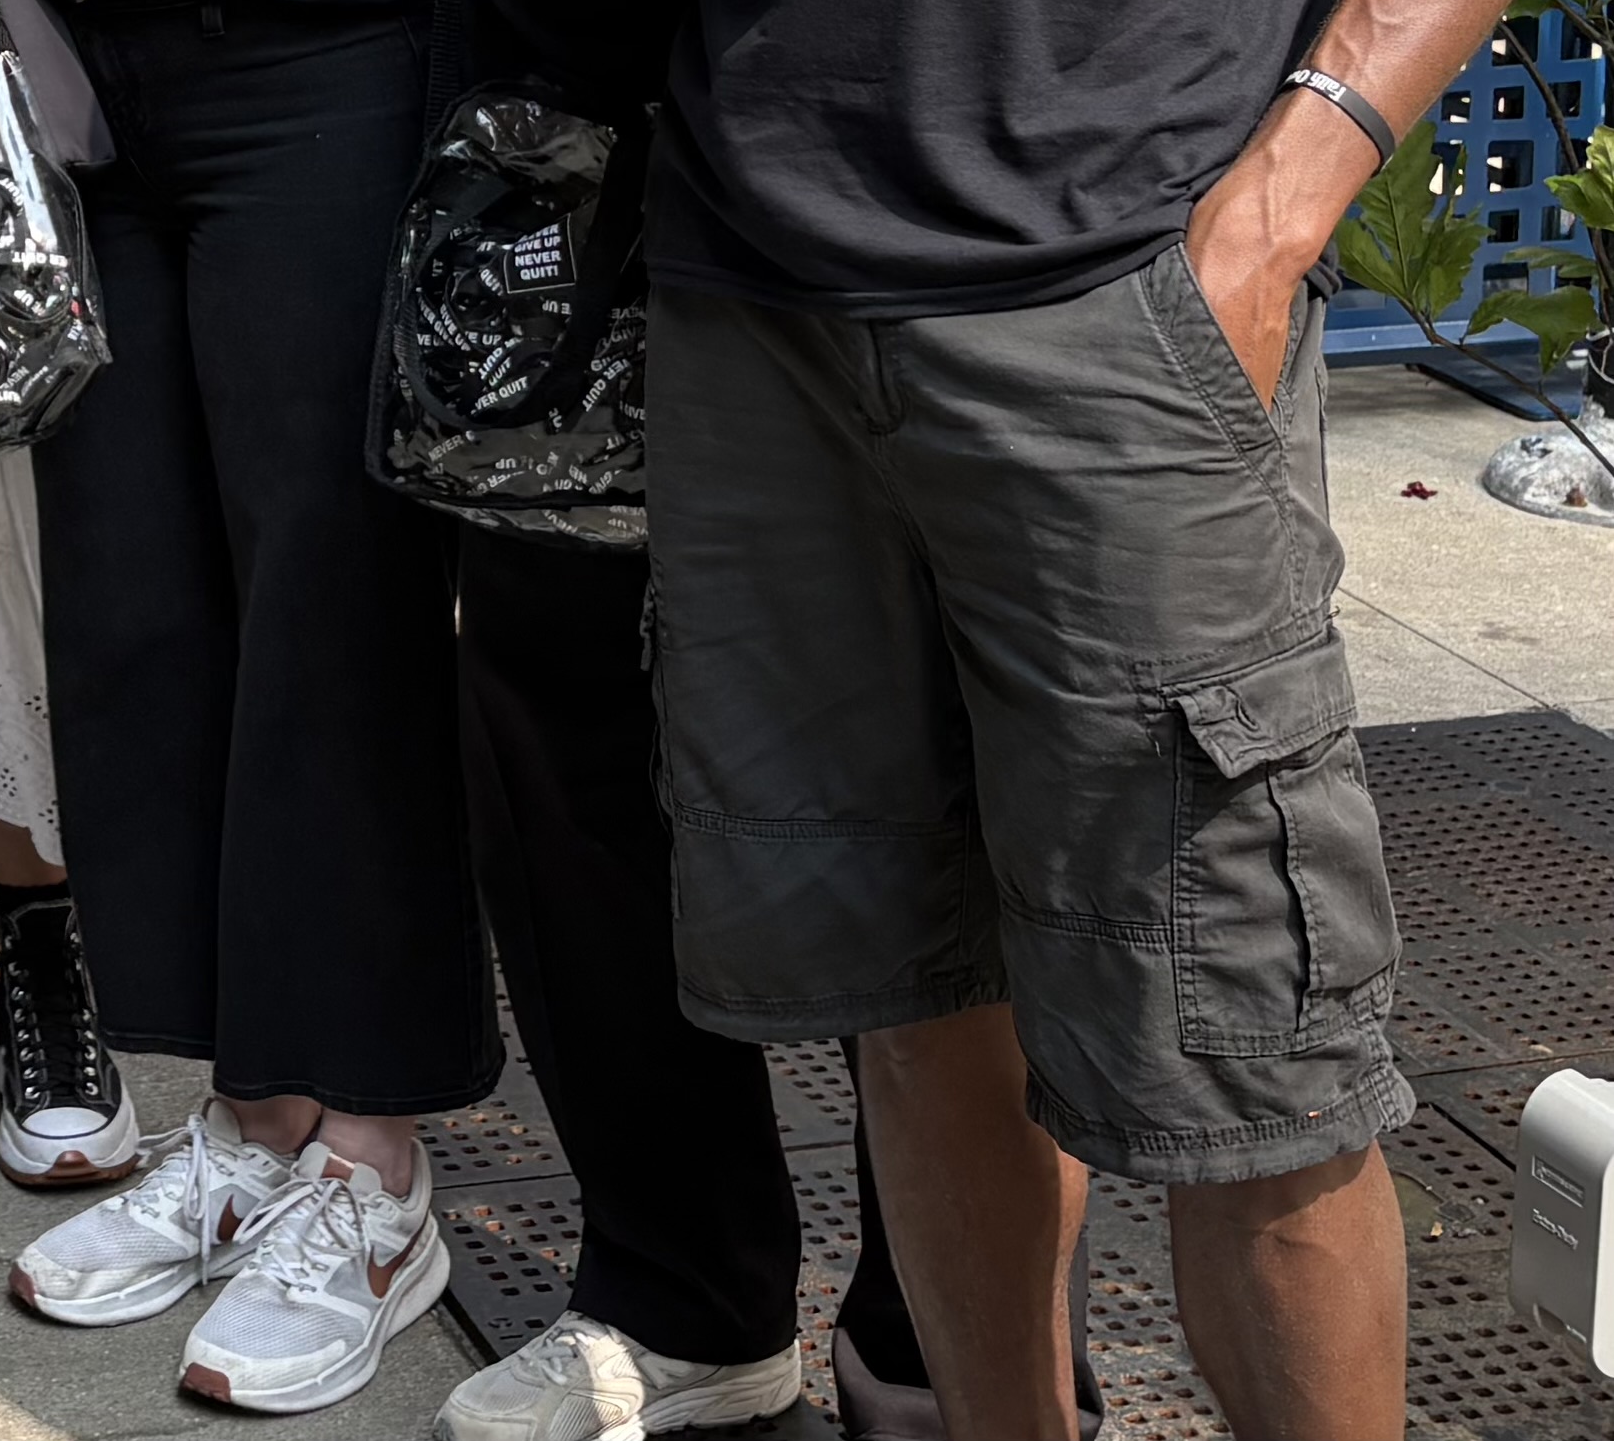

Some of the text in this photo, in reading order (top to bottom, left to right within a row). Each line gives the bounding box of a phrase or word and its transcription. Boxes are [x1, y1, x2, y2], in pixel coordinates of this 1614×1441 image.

[514, 236, 561, 253] GIVE UP
[515, 250, 562, 267] NEVER
[482, 334, 502, 346] UP
[499, 376, 528, 399] QUIT
[582, 379, 606, 412] QUIT
